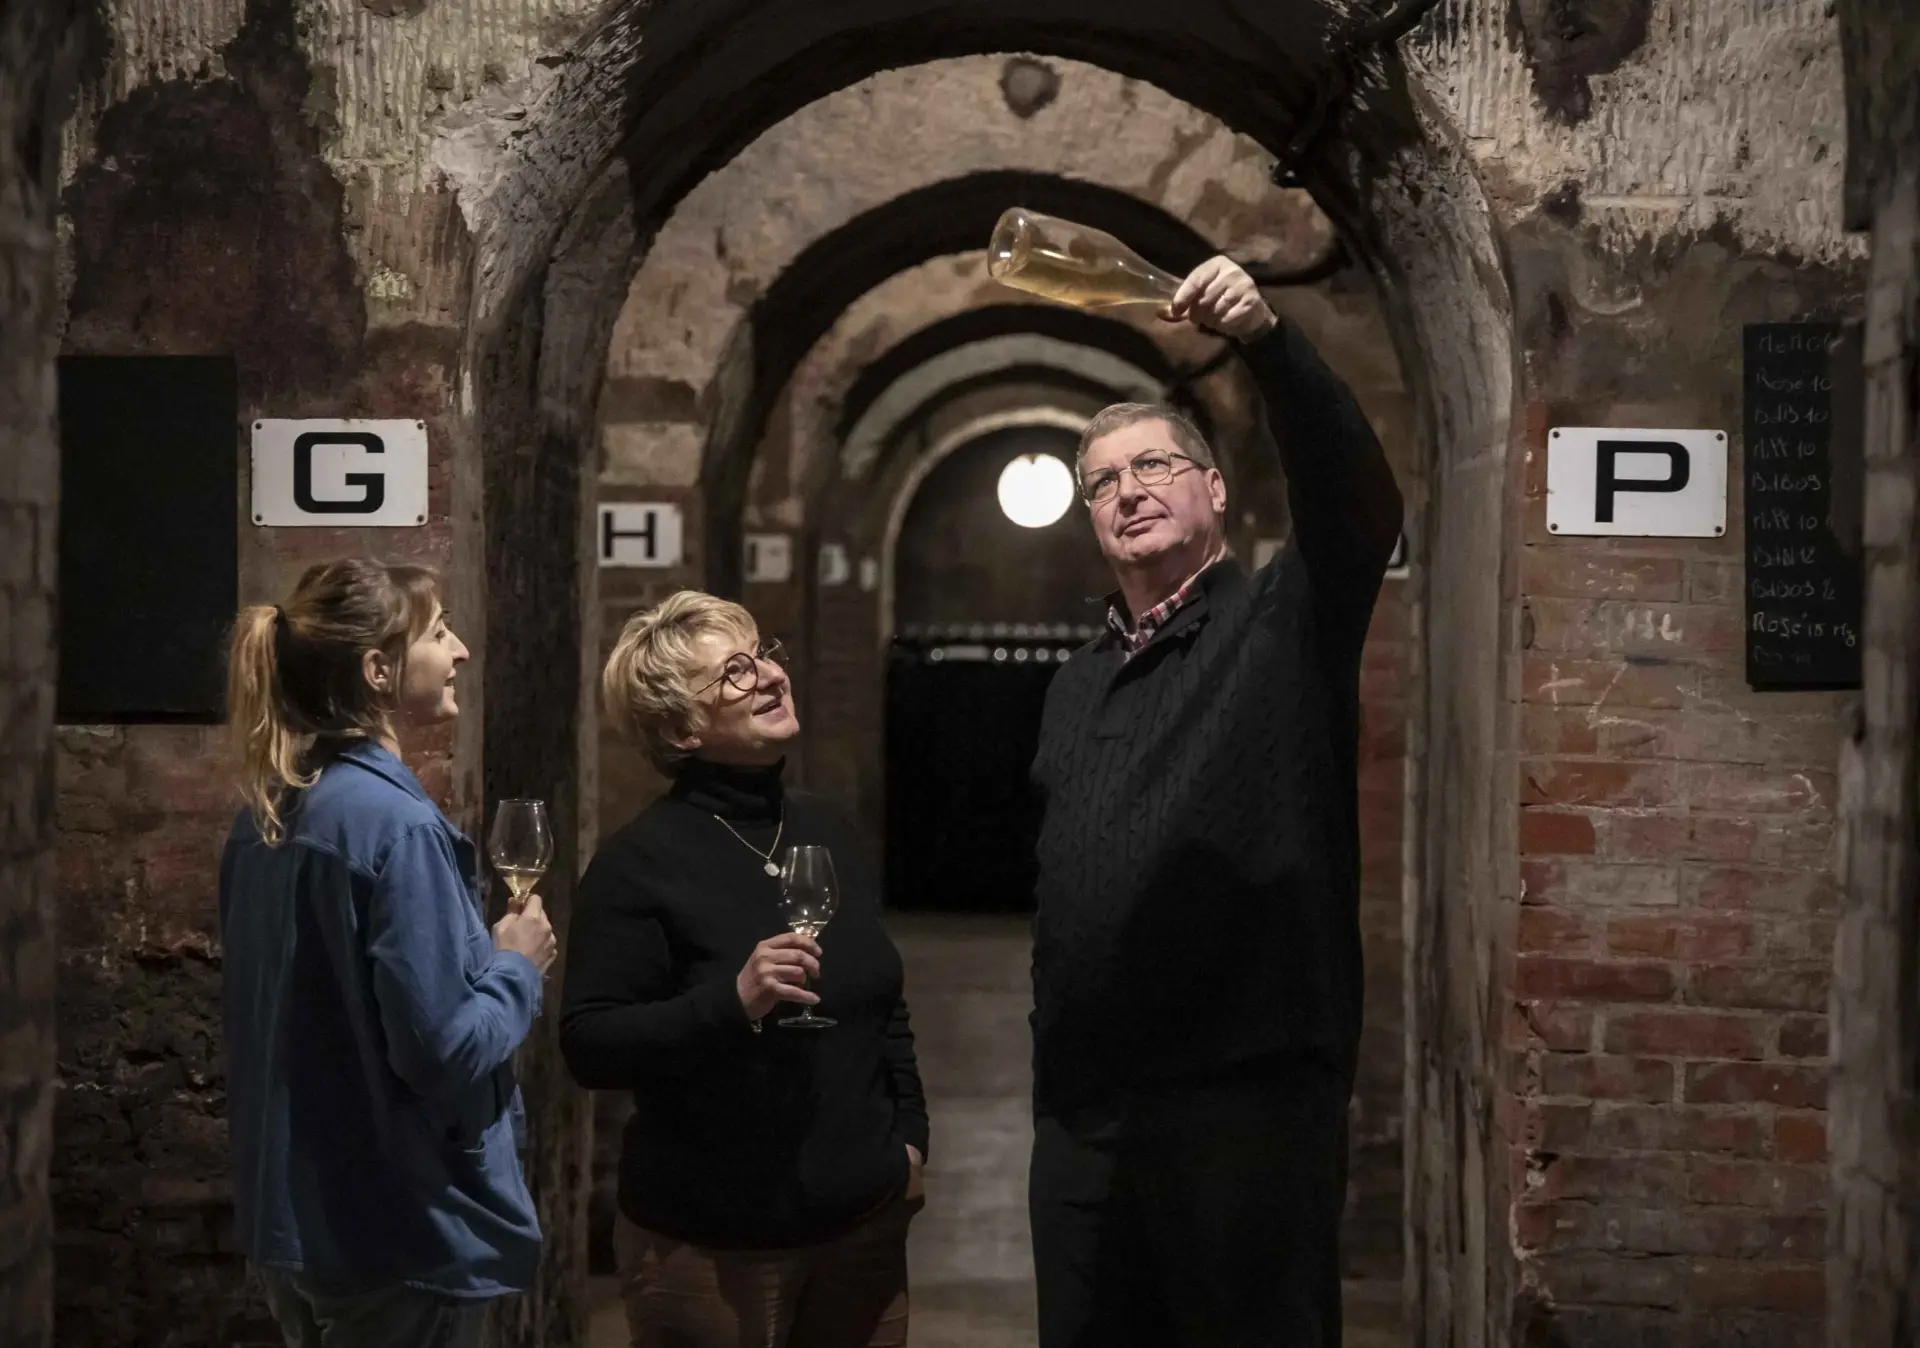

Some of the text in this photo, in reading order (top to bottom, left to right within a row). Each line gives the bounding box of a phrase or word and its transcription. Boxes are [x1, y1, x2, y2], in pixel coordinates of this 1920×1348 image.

[1809, 374, 1834, 393] 10
[1803, 406, 1829, 425] 10
[1795, 438, 1816, 459] 10
[293, 432, 385, 513] G
[1595, 440, 1690, 522] P
[1797, 514, 1818, 532] 10
[604, 511, 656, 559] H
